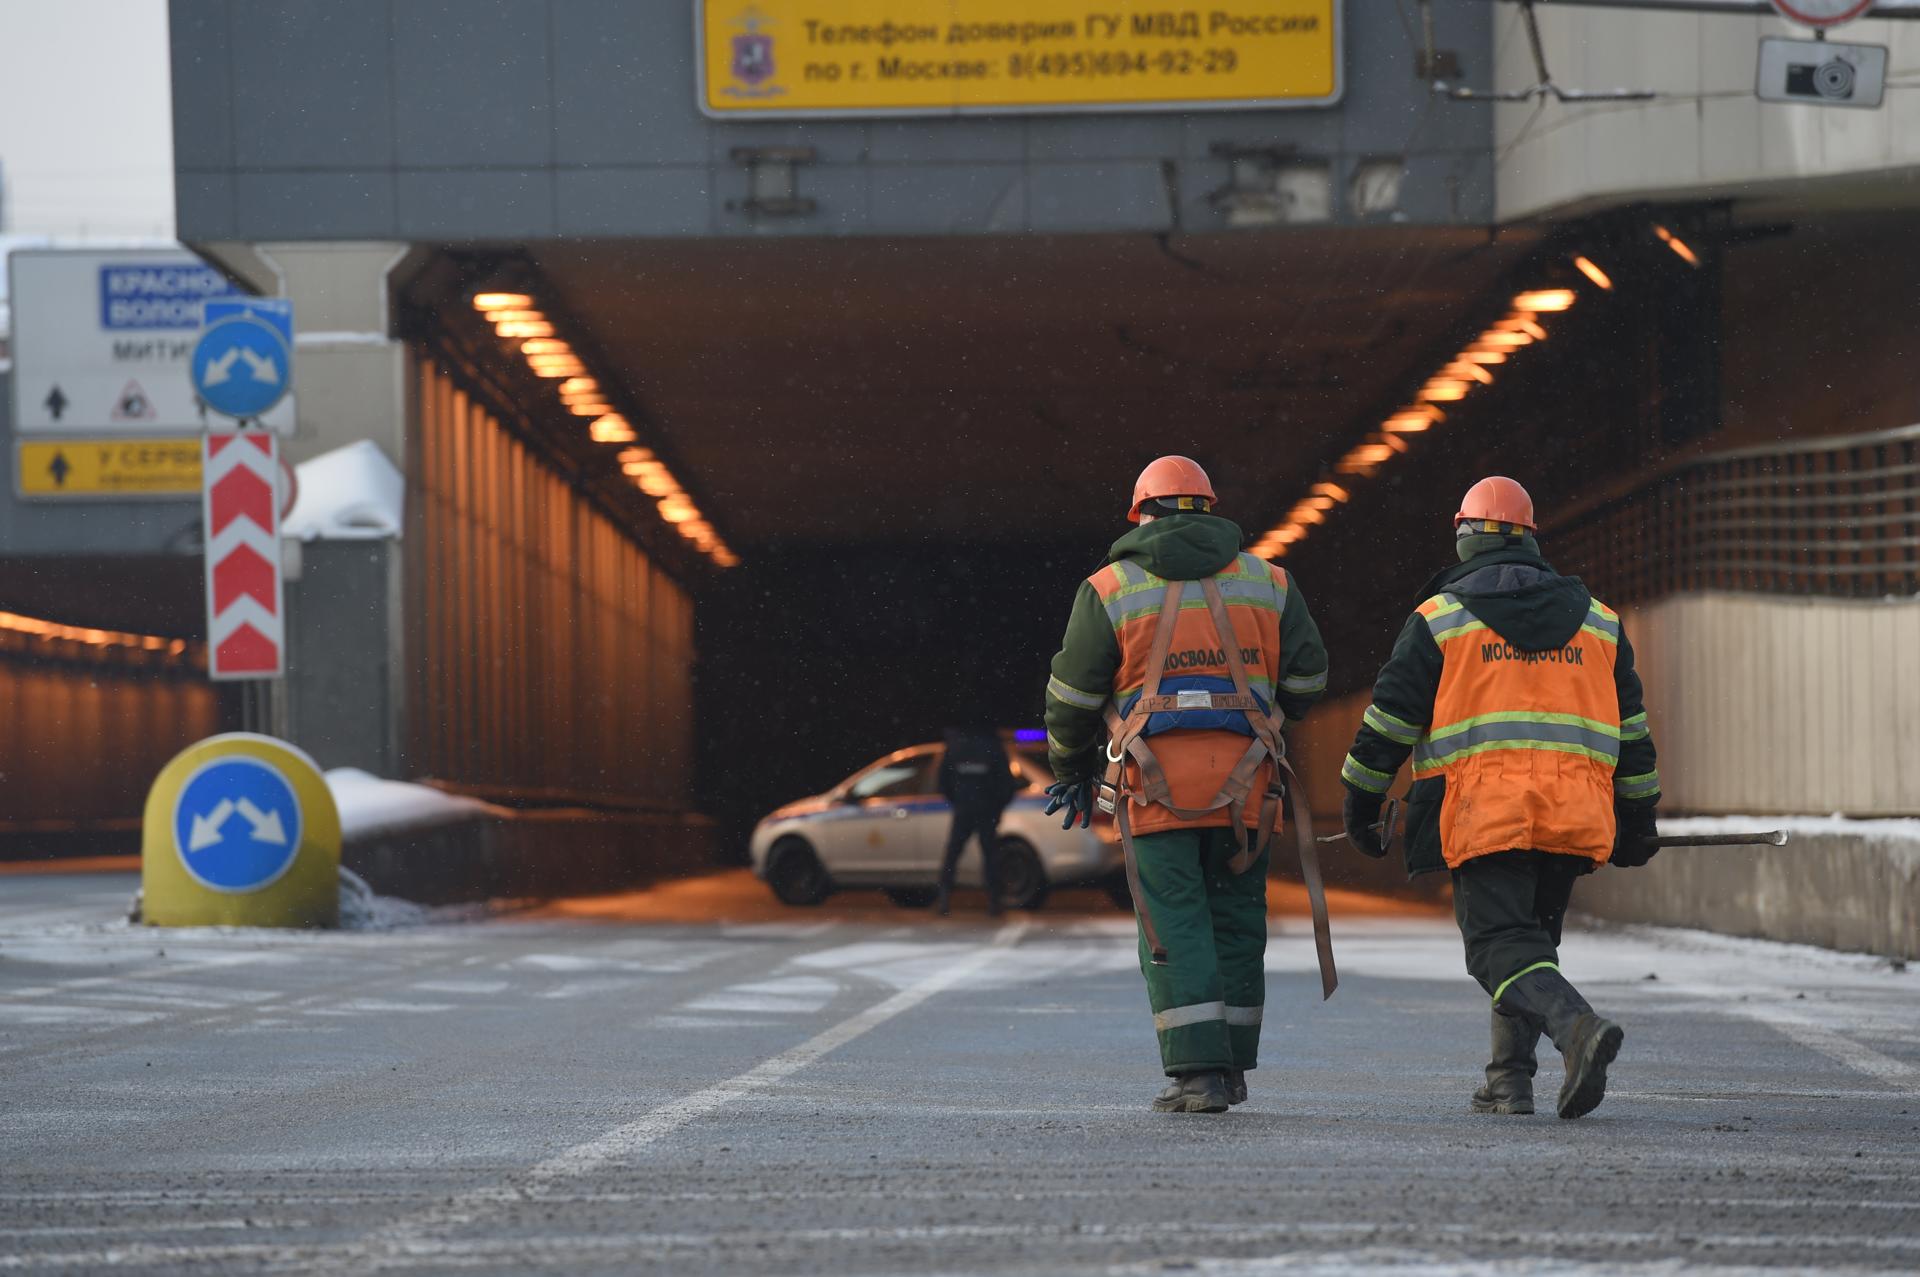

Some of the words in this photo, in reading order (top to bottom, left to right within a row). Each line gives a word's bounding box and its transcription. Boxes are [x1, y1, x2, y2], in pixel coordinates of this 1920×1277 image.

[804, 20, 939, 47] Телефон
[947, 20, 1076, 45] доверия
[1086, 14, 1121, 38] ГУ
[1132, 12, 1200, 39] МВД
[1210, 11, 1319, 35] России
[804, 61, 842, 82] по
[850, 61, 869, 80] г.
[877, 56, 1000, 80] Москве:
[1009, 48, 1238, 82] 8(495)694-92-29
[1164, 647, 1260, 671] ОСВОДООК
